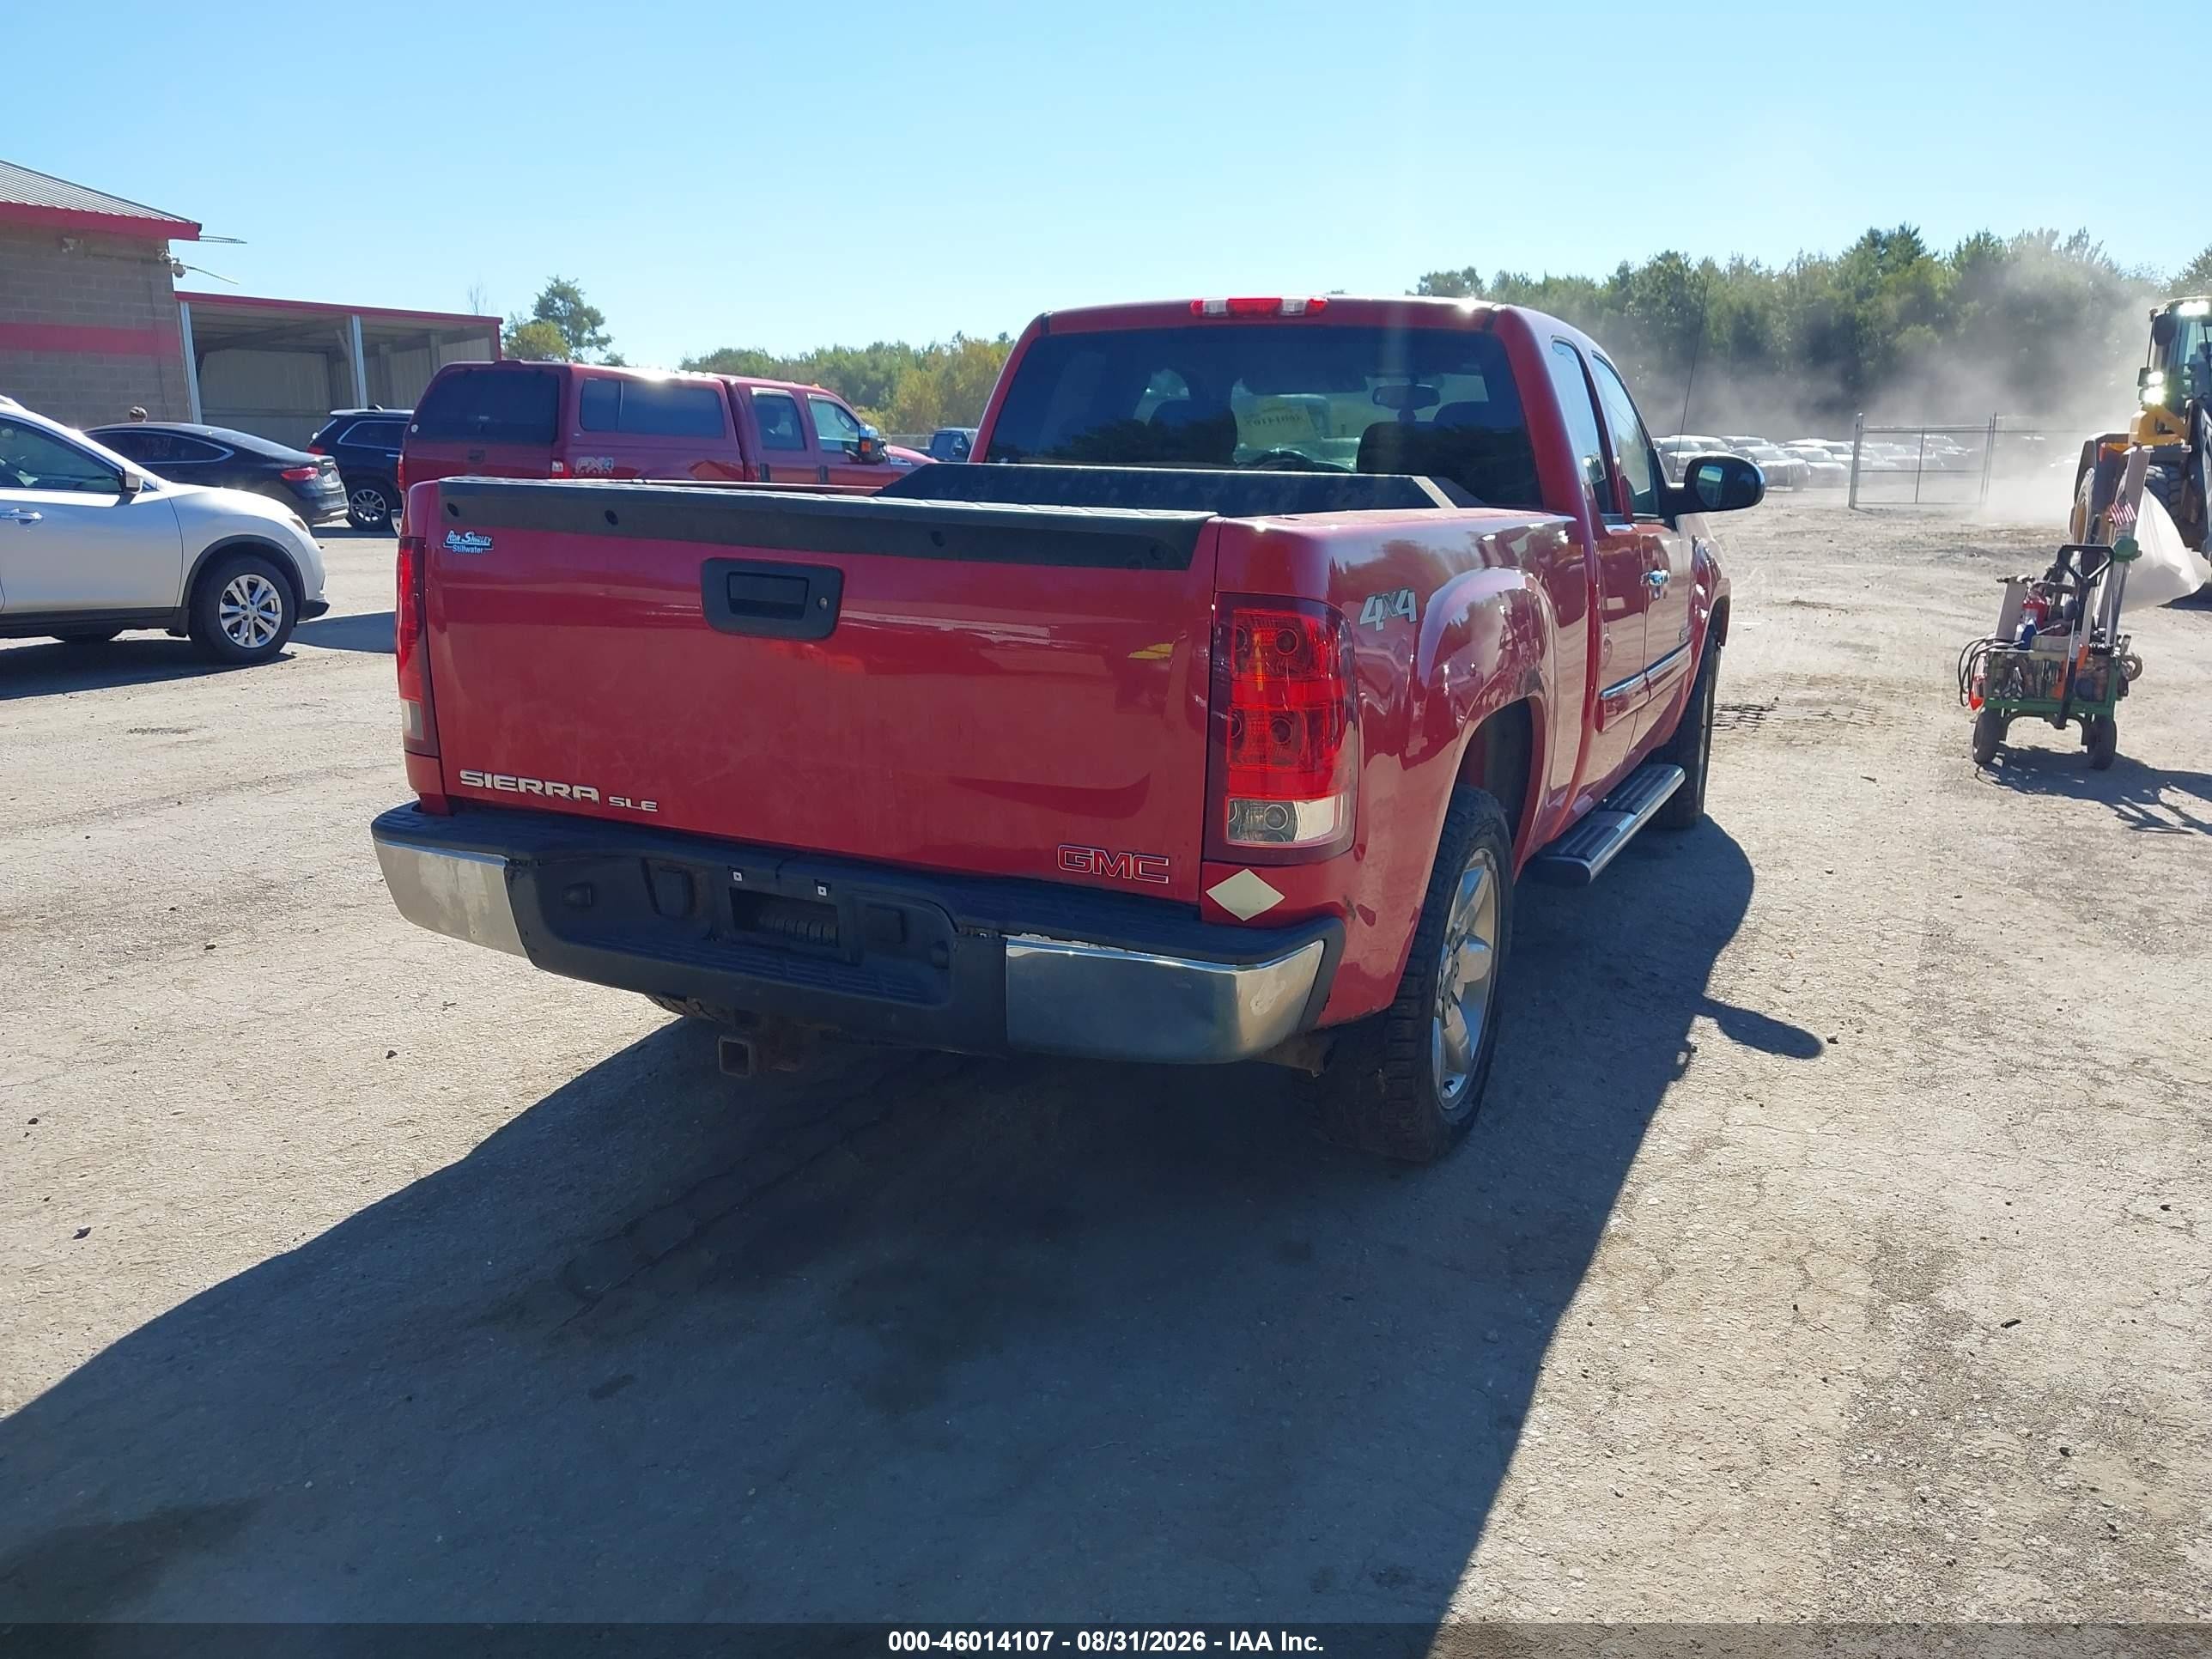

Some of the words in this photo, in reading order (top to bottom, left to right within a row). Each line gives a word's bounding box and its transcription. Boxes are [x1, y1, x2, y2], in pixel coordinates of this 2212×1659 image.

[453, 544, 483, 553] Stillwater
[459, 769, 600, 804] SIERRA
[608, 796, 659, 812] SLE
[1057, 844, 1170, 884] GMC
